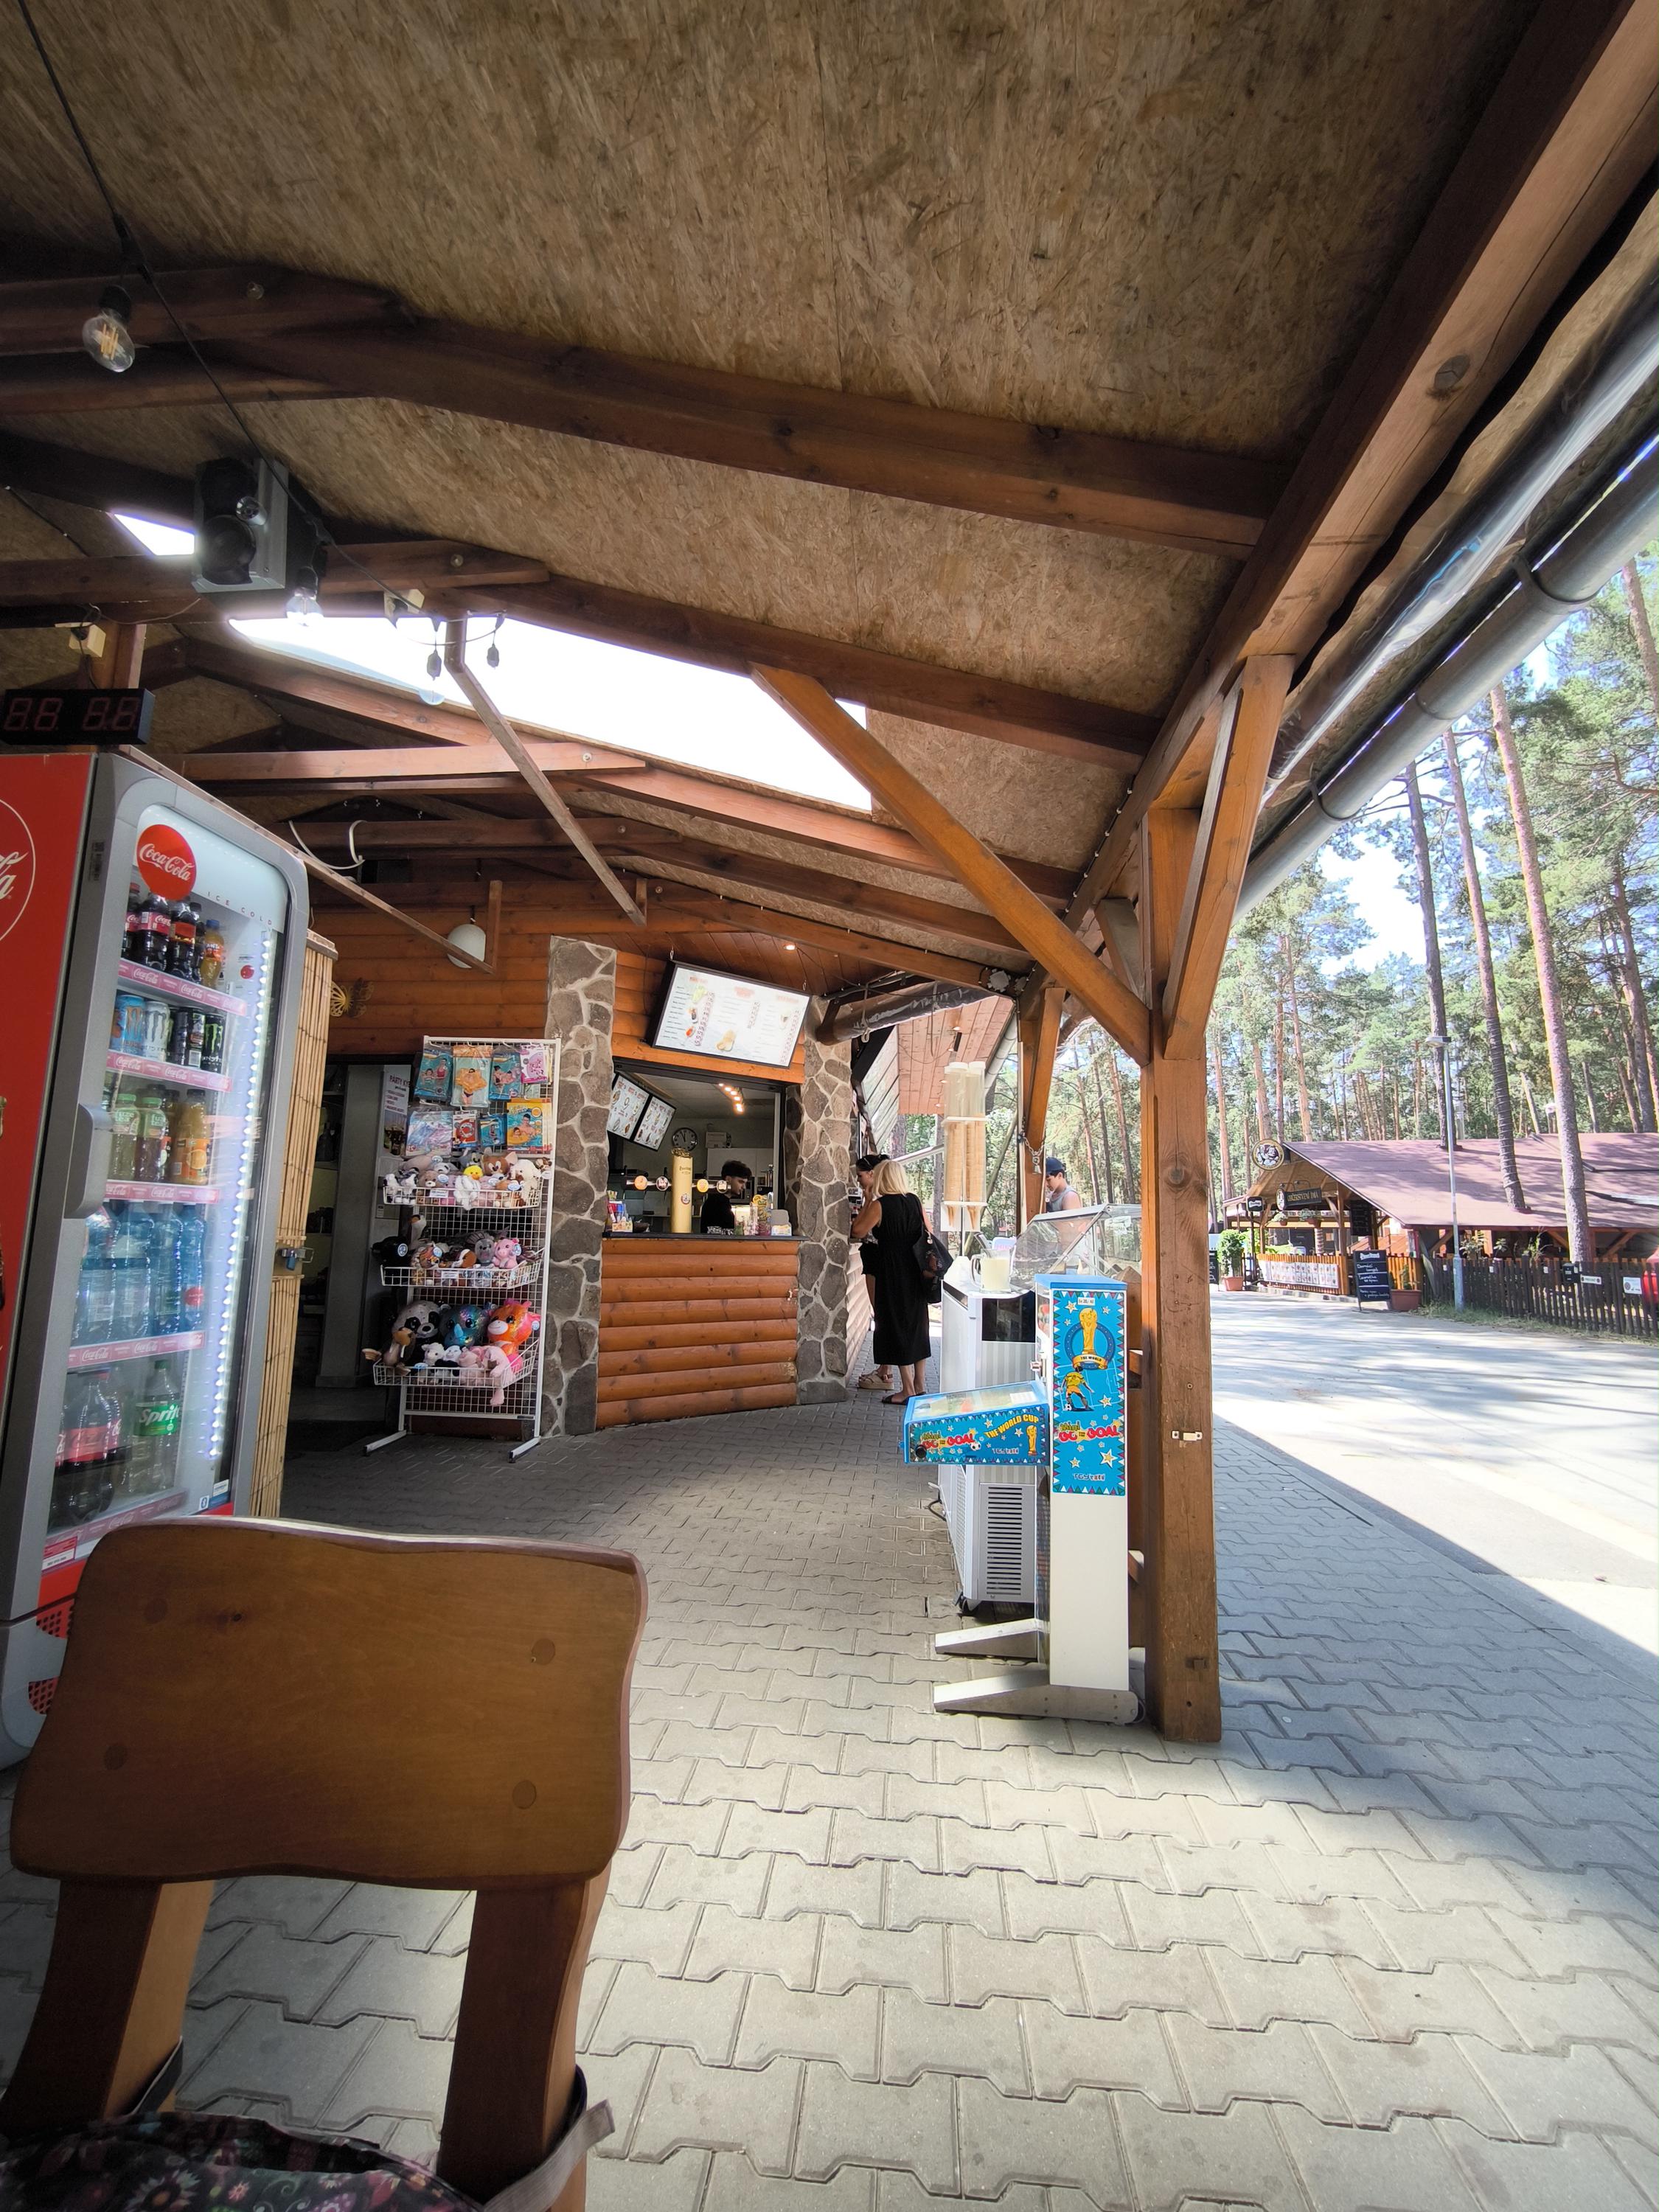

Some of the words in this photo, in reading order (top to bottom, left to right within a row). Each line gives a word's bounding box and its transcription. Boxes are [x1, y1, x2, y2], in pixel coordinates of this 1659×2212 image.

[139, 843, 195, 881] Coca-Cola
[207, 891, 230, 905] ICE
[241, 907, 272, 925] COLD
[984, 1429, 998, 1438] THE
[998, 1416, 1022, 1433] WORLD
[1023, 1414, 1039, 1423] CUP
[1087, 1425, 1120, 1439] GOAL
[947, 1433, 975, 1446] GOAL
